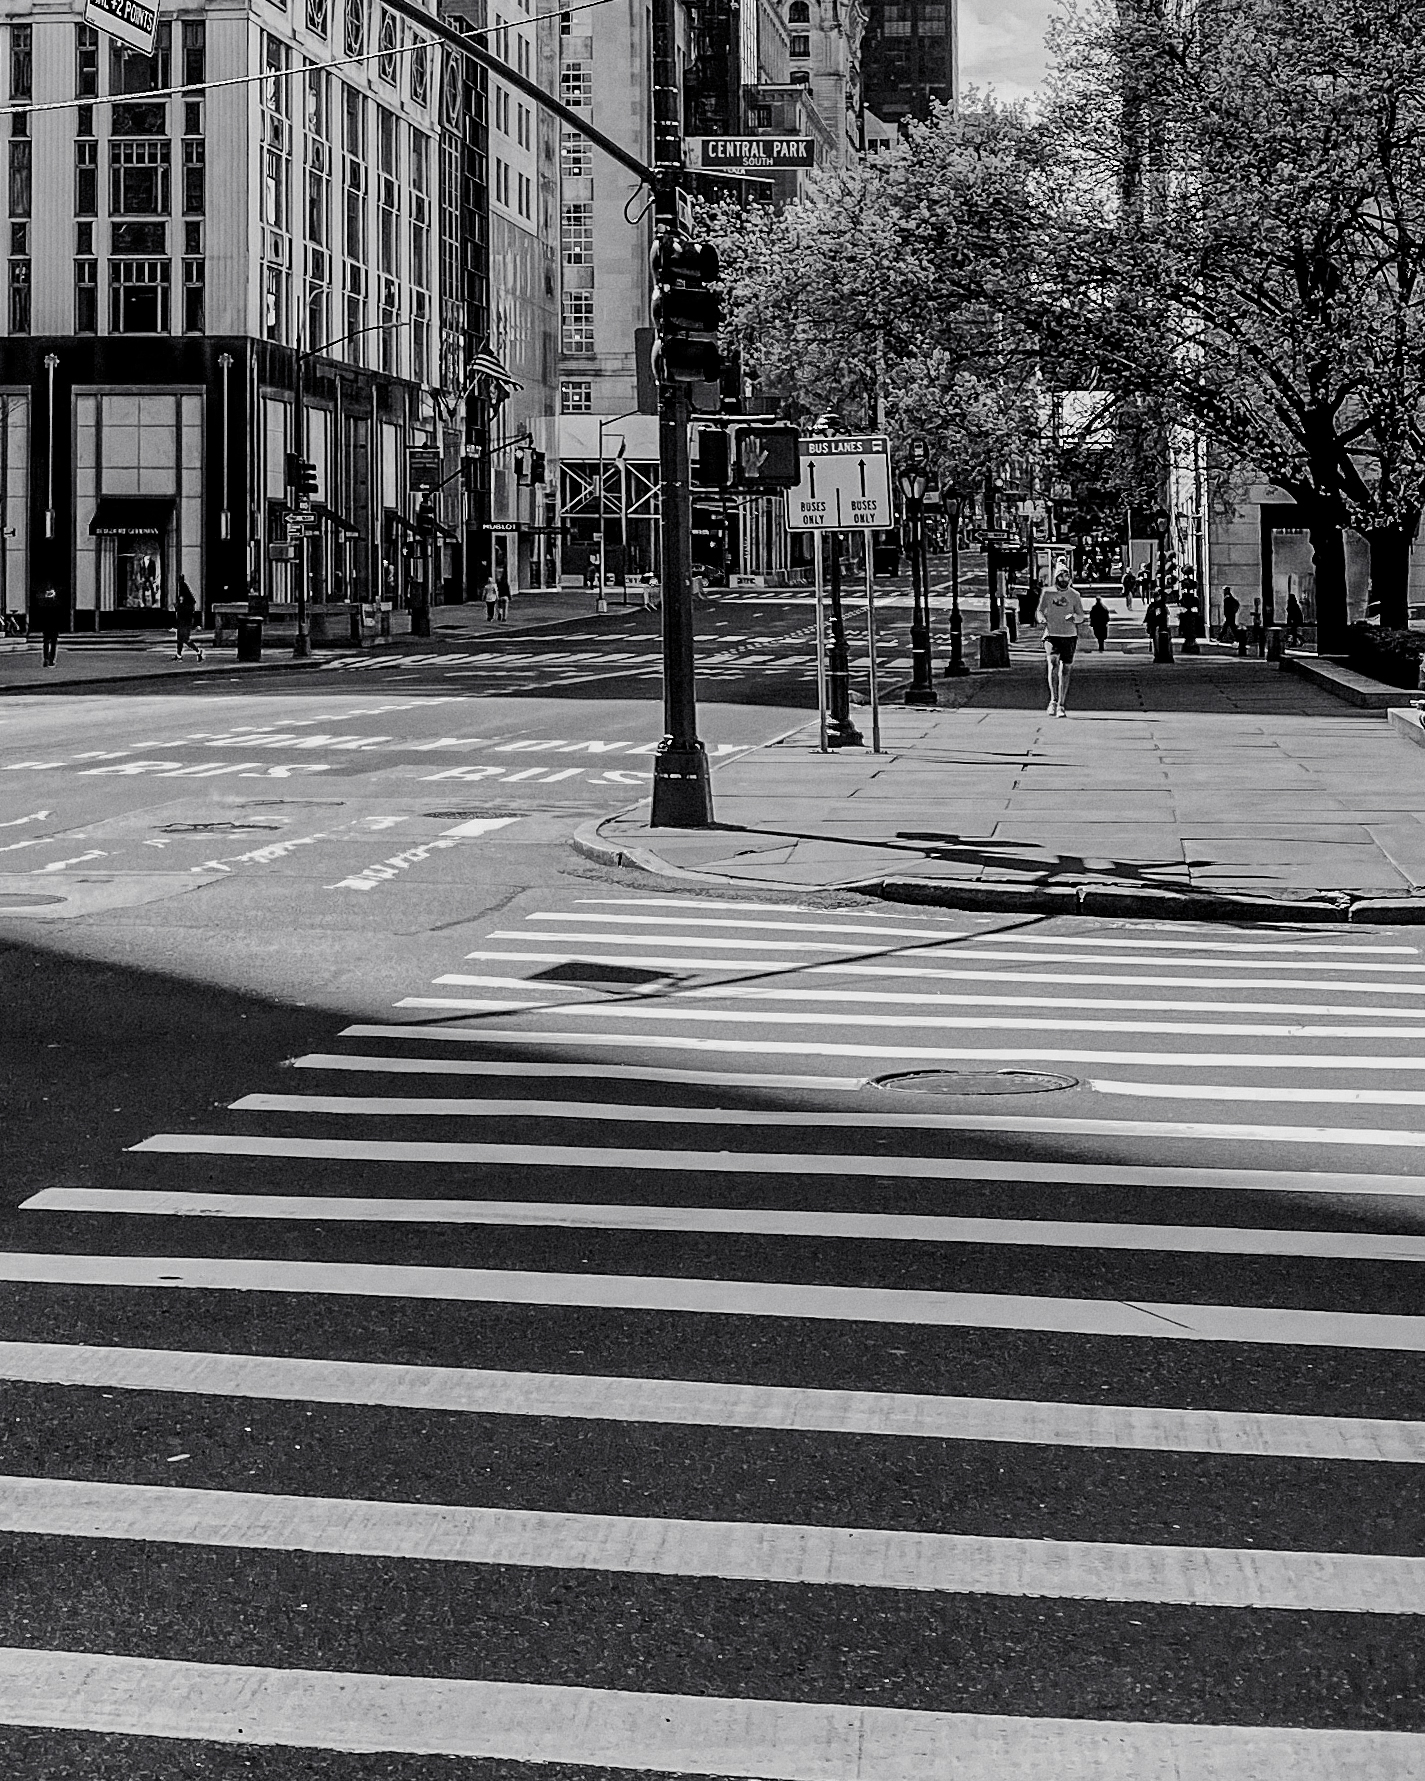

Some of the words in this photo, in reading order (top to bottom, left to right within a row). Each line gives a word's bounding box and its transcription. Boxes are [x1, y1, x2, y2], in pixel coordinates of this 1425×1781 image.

[123, 0, 154, 31] POINTS
[708, 141, 767, 158] CENTRAL
[773, 141, 807, 158] PARK
[742, 157, 774, 166] SOUTH
[808, 442, 829, 454] BUS
[831, 441, 863, 453] LANES
[800, 501, 826, 512] BUSES
[850, 500, 877, 511] BUSES
[802, 515, 825, 525] ONLY
[853, 513, 876, 524] ONLY
[76, 761, 331, 777] BUS
[418, 766, 655, 785] BUS
